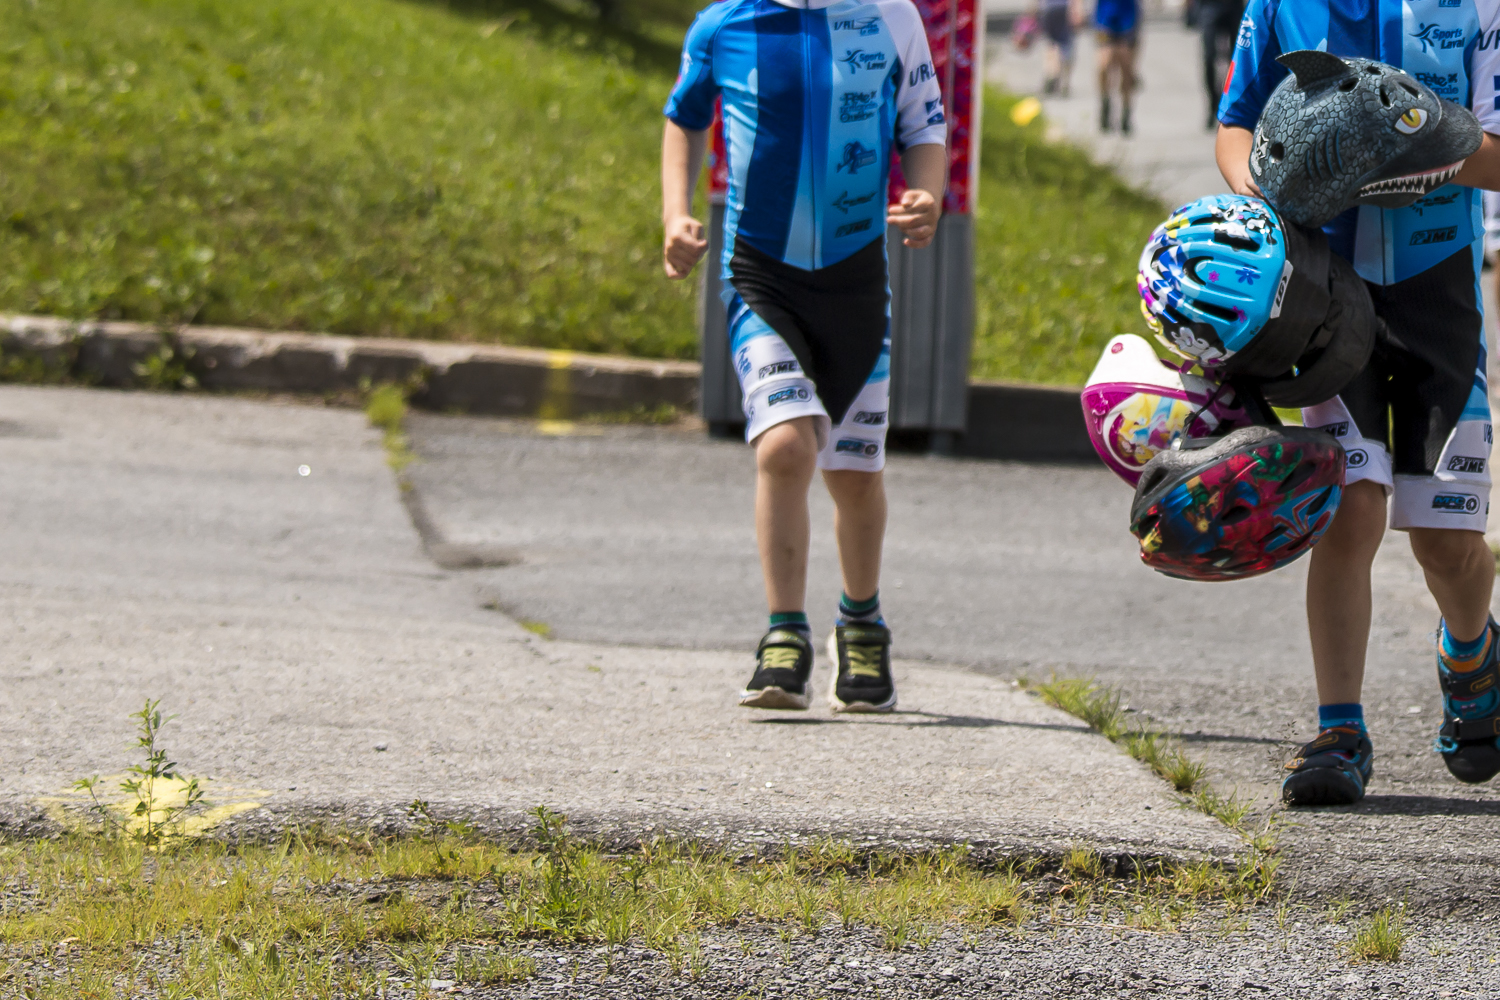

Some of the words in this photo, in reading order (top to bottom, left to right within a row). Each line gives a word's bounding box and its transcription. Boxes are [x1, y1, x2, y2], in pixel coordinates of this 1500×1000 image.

[1432, 28, 1462, 41] Sports
[1441, 38, 1465, 49] Laval
[1423, 229, 1454, 243] JMC
[1434, 495, 1465, 505] MPC
